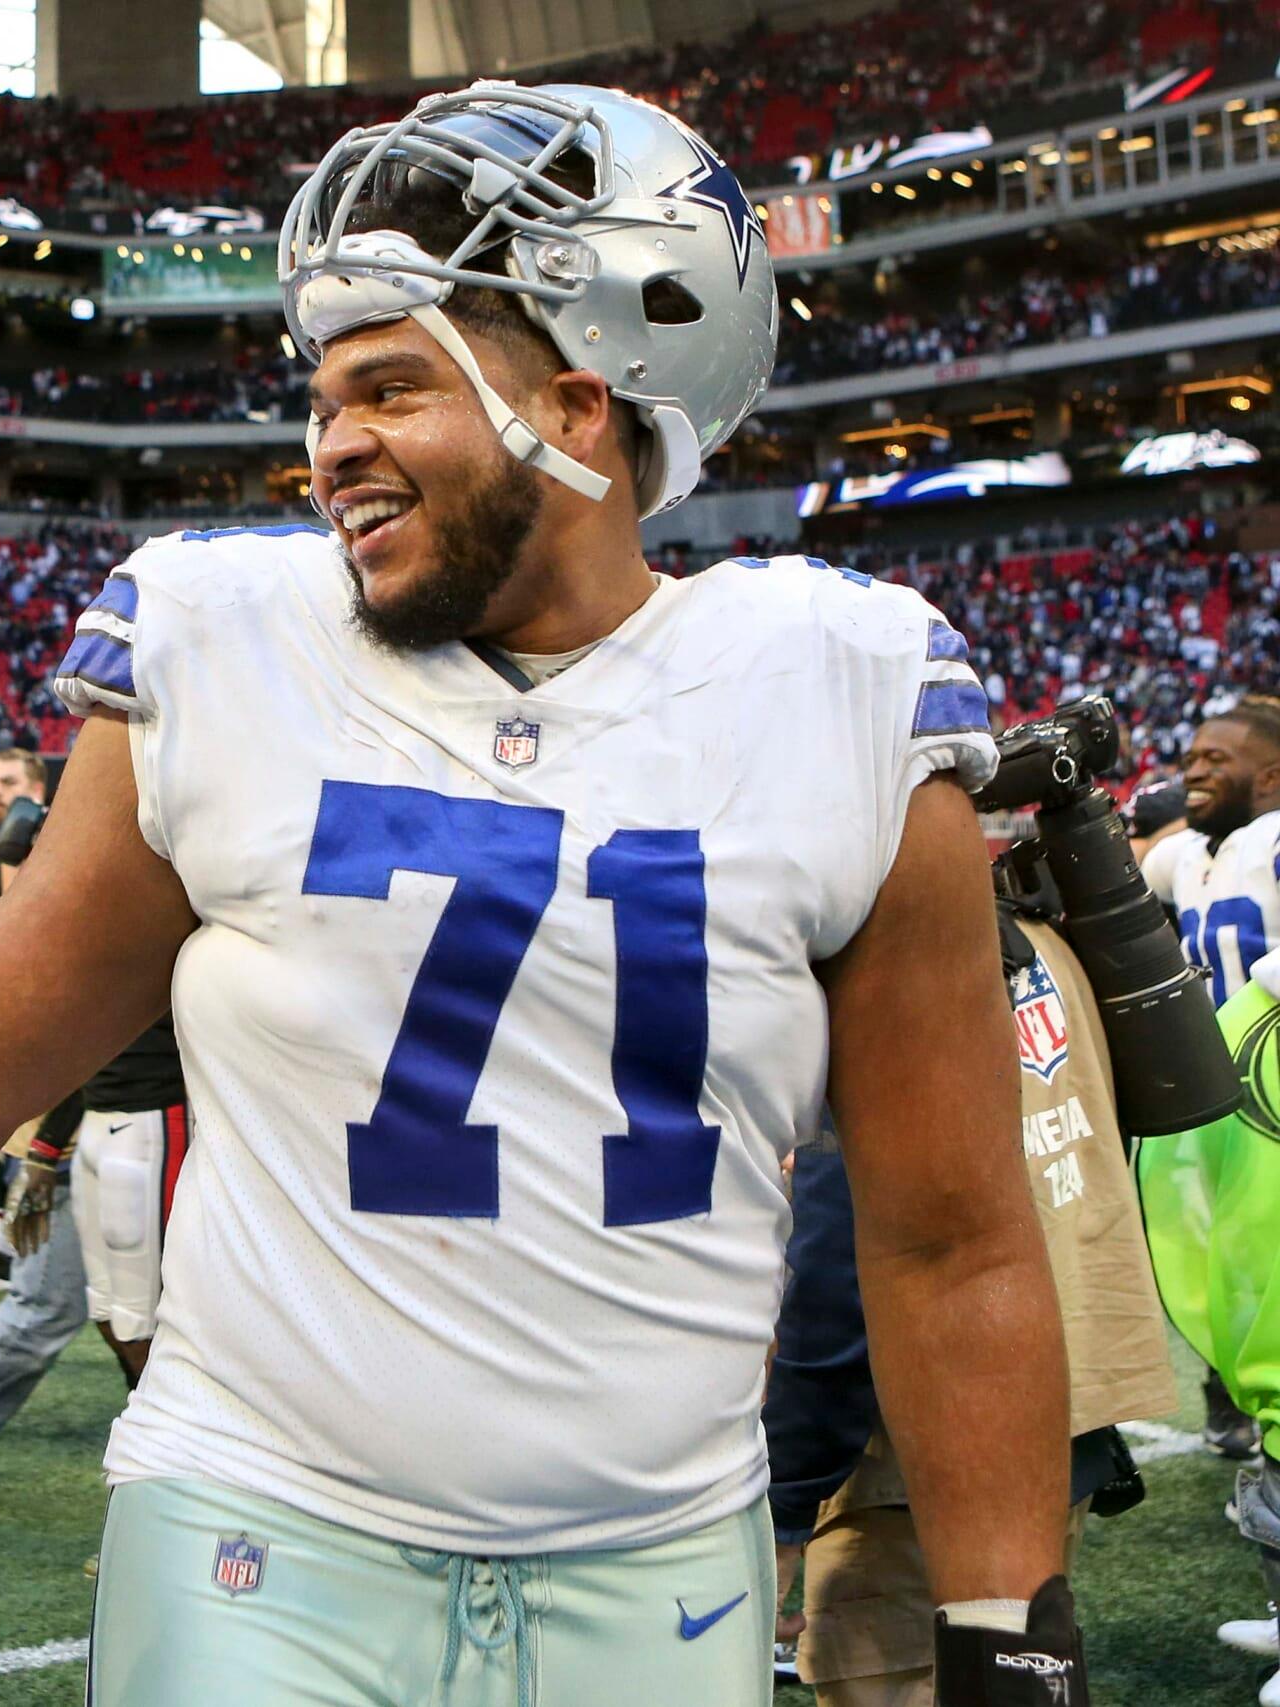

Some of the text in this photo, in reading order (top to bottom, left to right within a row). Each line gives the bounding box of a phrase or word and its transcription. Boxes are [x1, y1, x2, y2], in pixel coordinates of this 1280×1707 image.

[498, 739, 533, 762] NFL
[301, 779, 721, 1227] 71
[219, 1560, 256, 1587] NFL
